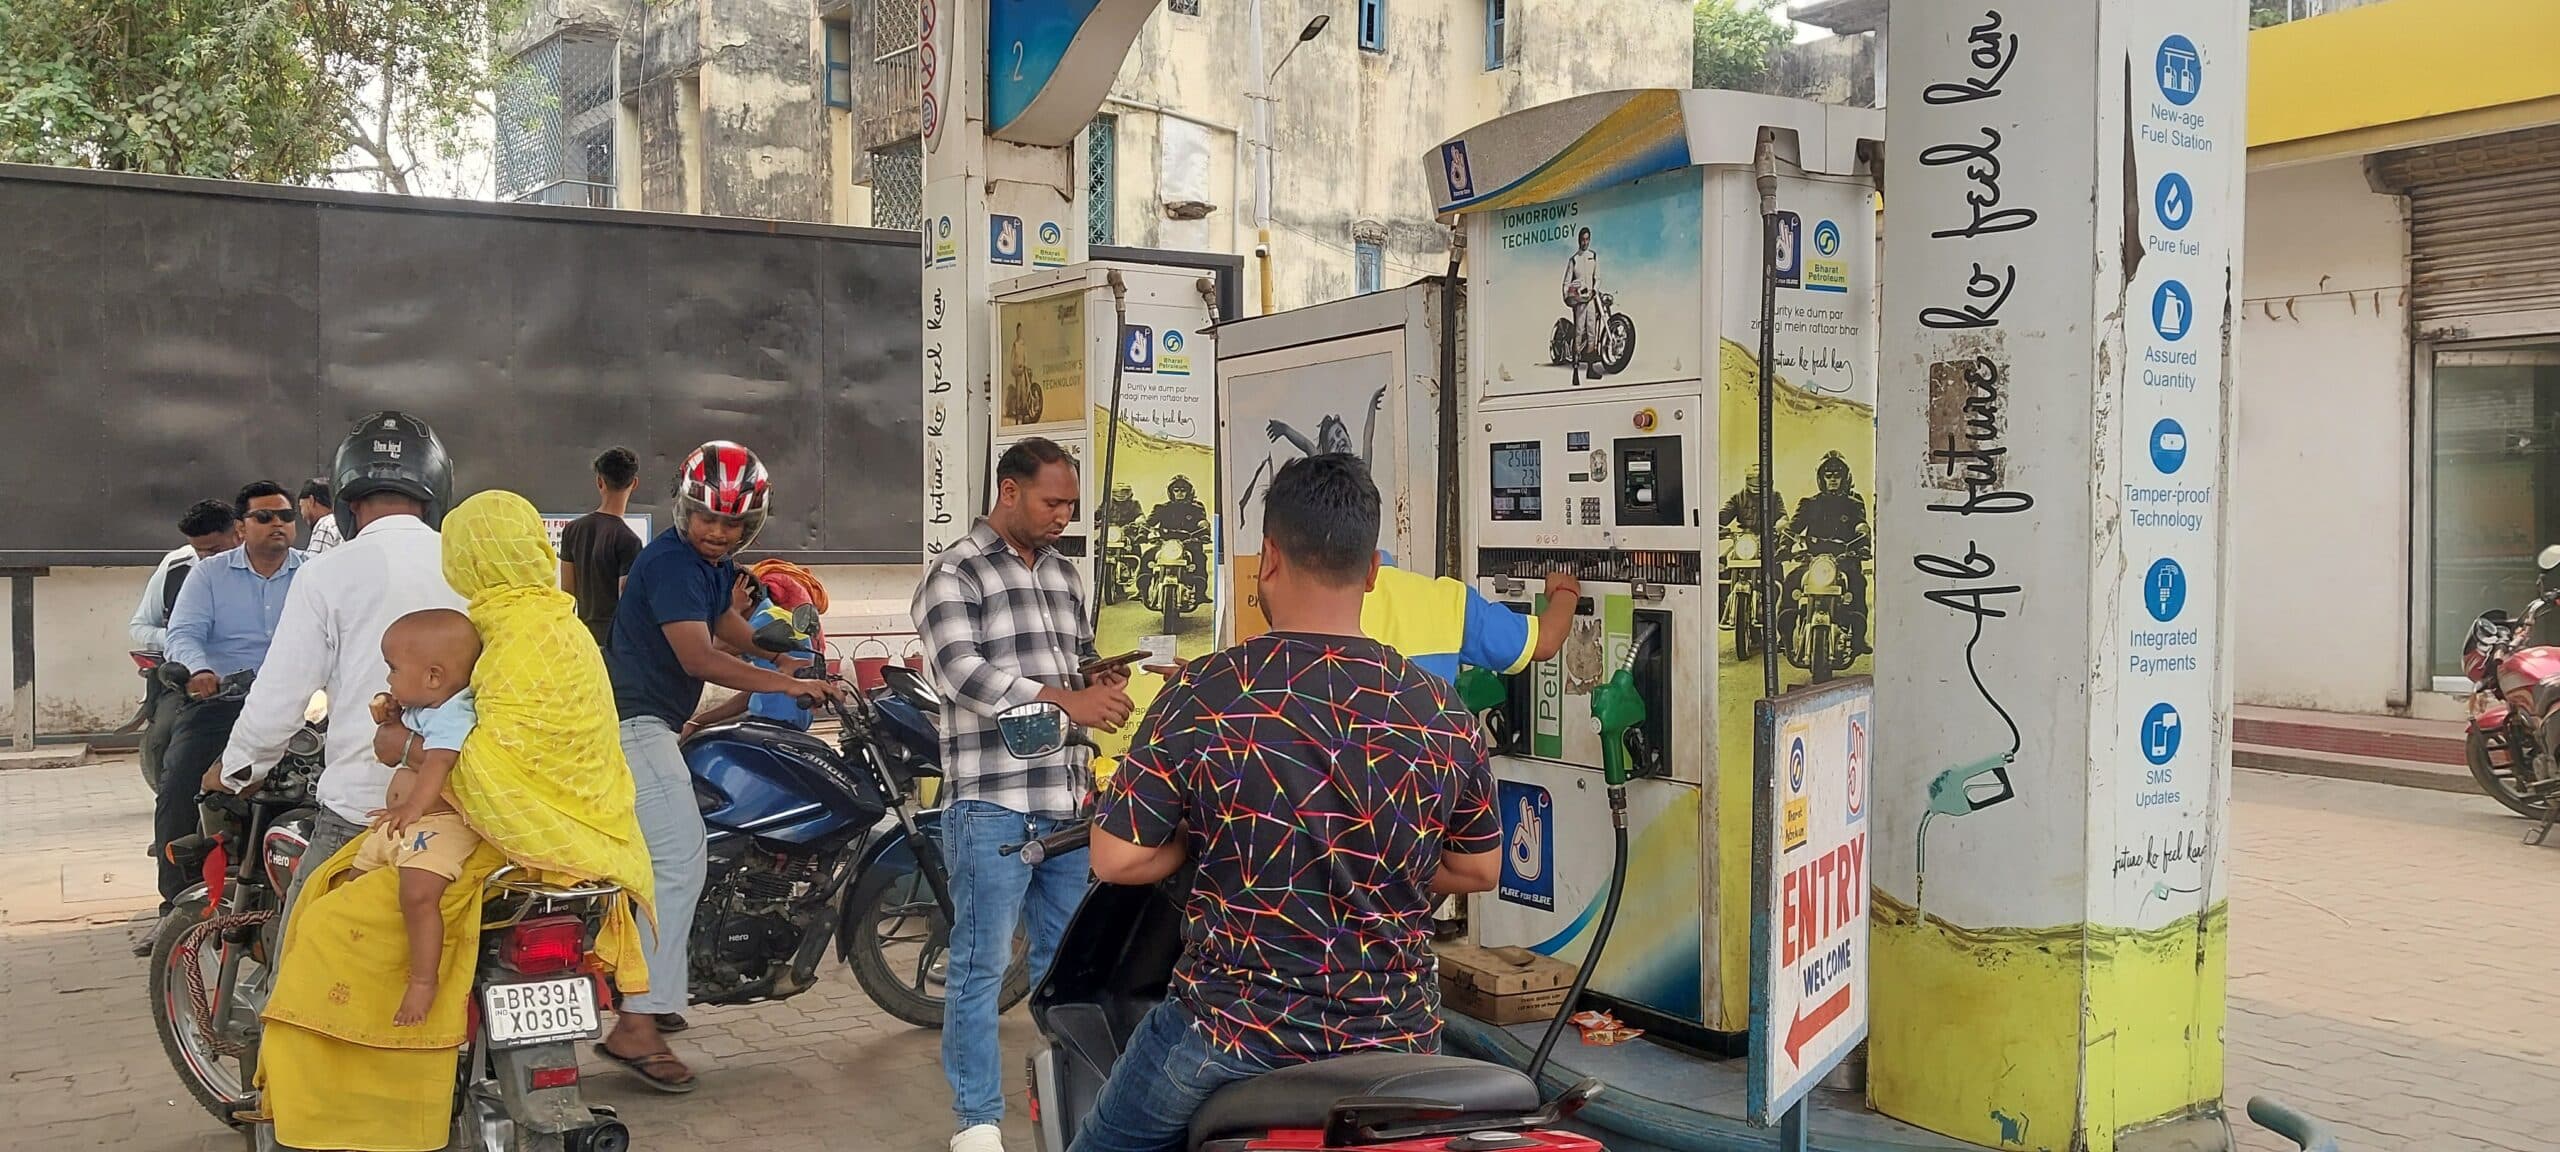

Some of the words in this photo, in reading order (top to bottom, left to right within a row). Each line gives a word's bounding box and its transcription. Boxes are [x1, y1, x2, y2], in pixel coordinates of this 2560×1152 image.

[1012, 41, 1024, 81] 2
[2151, 103, 2205, 129] New-age
[2141, 124, 2168, 144] Fuel
[2171, 130, 2213, 152] Station
[1919, 126, 2037, 238] feel
[1502, 202, 1579, 230] TOMORROW'S
[1501, 223, 1578, 250] TECHNOLOGY
[2149, 235, 2176, 254] Pure
[2179, 239, 2200, 256] fuel
[1808, 271, 1845, 283] Petroleum
[1814, 263, 1839, 274] Bharat
[1919, 262, 2015, 329] ko
[1775, 305, 1793, 318] urity
[1795, 306, 1805, 317] ke
[1807, 307, 1828, 319] dum
[1829, 310, 1844, 321] par
[1785, 321, 1807, 332] mein
[1809, 322, 1838, 335] raftaar
[1840, 325, 1860, 336] bhar
[2145, 345, 2197, 365] Assured
[926, 342, 951, 394] feel
[1127, 383, 1147, 393] Purity
[1158, 385, 1175, 393] dum
[2143, 369, 2196, 392] Quantity
[1120, 392, 1139, 401] ndagi
[927, 407, 946, 437] ko
[1926, 355, 2034, 516] future
[929, 449, 952, 524] future
[2124, 484, 2210, 506] Tamper-proof
[2130, 508, 2203, 531] Technology
[1913, 540, 2021, 618] Ab
[2130, 628, 2197, 650] Integrated
[2130, 655, 2196, 676] Payments
[2146, 769, 2172, 785] SMS
[2135, 792, 2181, 807] Updates
[273, 853, 289, 868] Hero
[2162, 830, 2183, 874] feel
[1500, 885, 1520, 899] PURE
[1532, 893, 1552, 906] SURE
[1783, 832, 1865, 969] ENTRY
[728, 934, 749, 942] Hero
[1803, 937, 1851, 998] WELCOME
[507, 982, 578, 1010] BR39A
[510, 1007, 583, 1033] X0305
